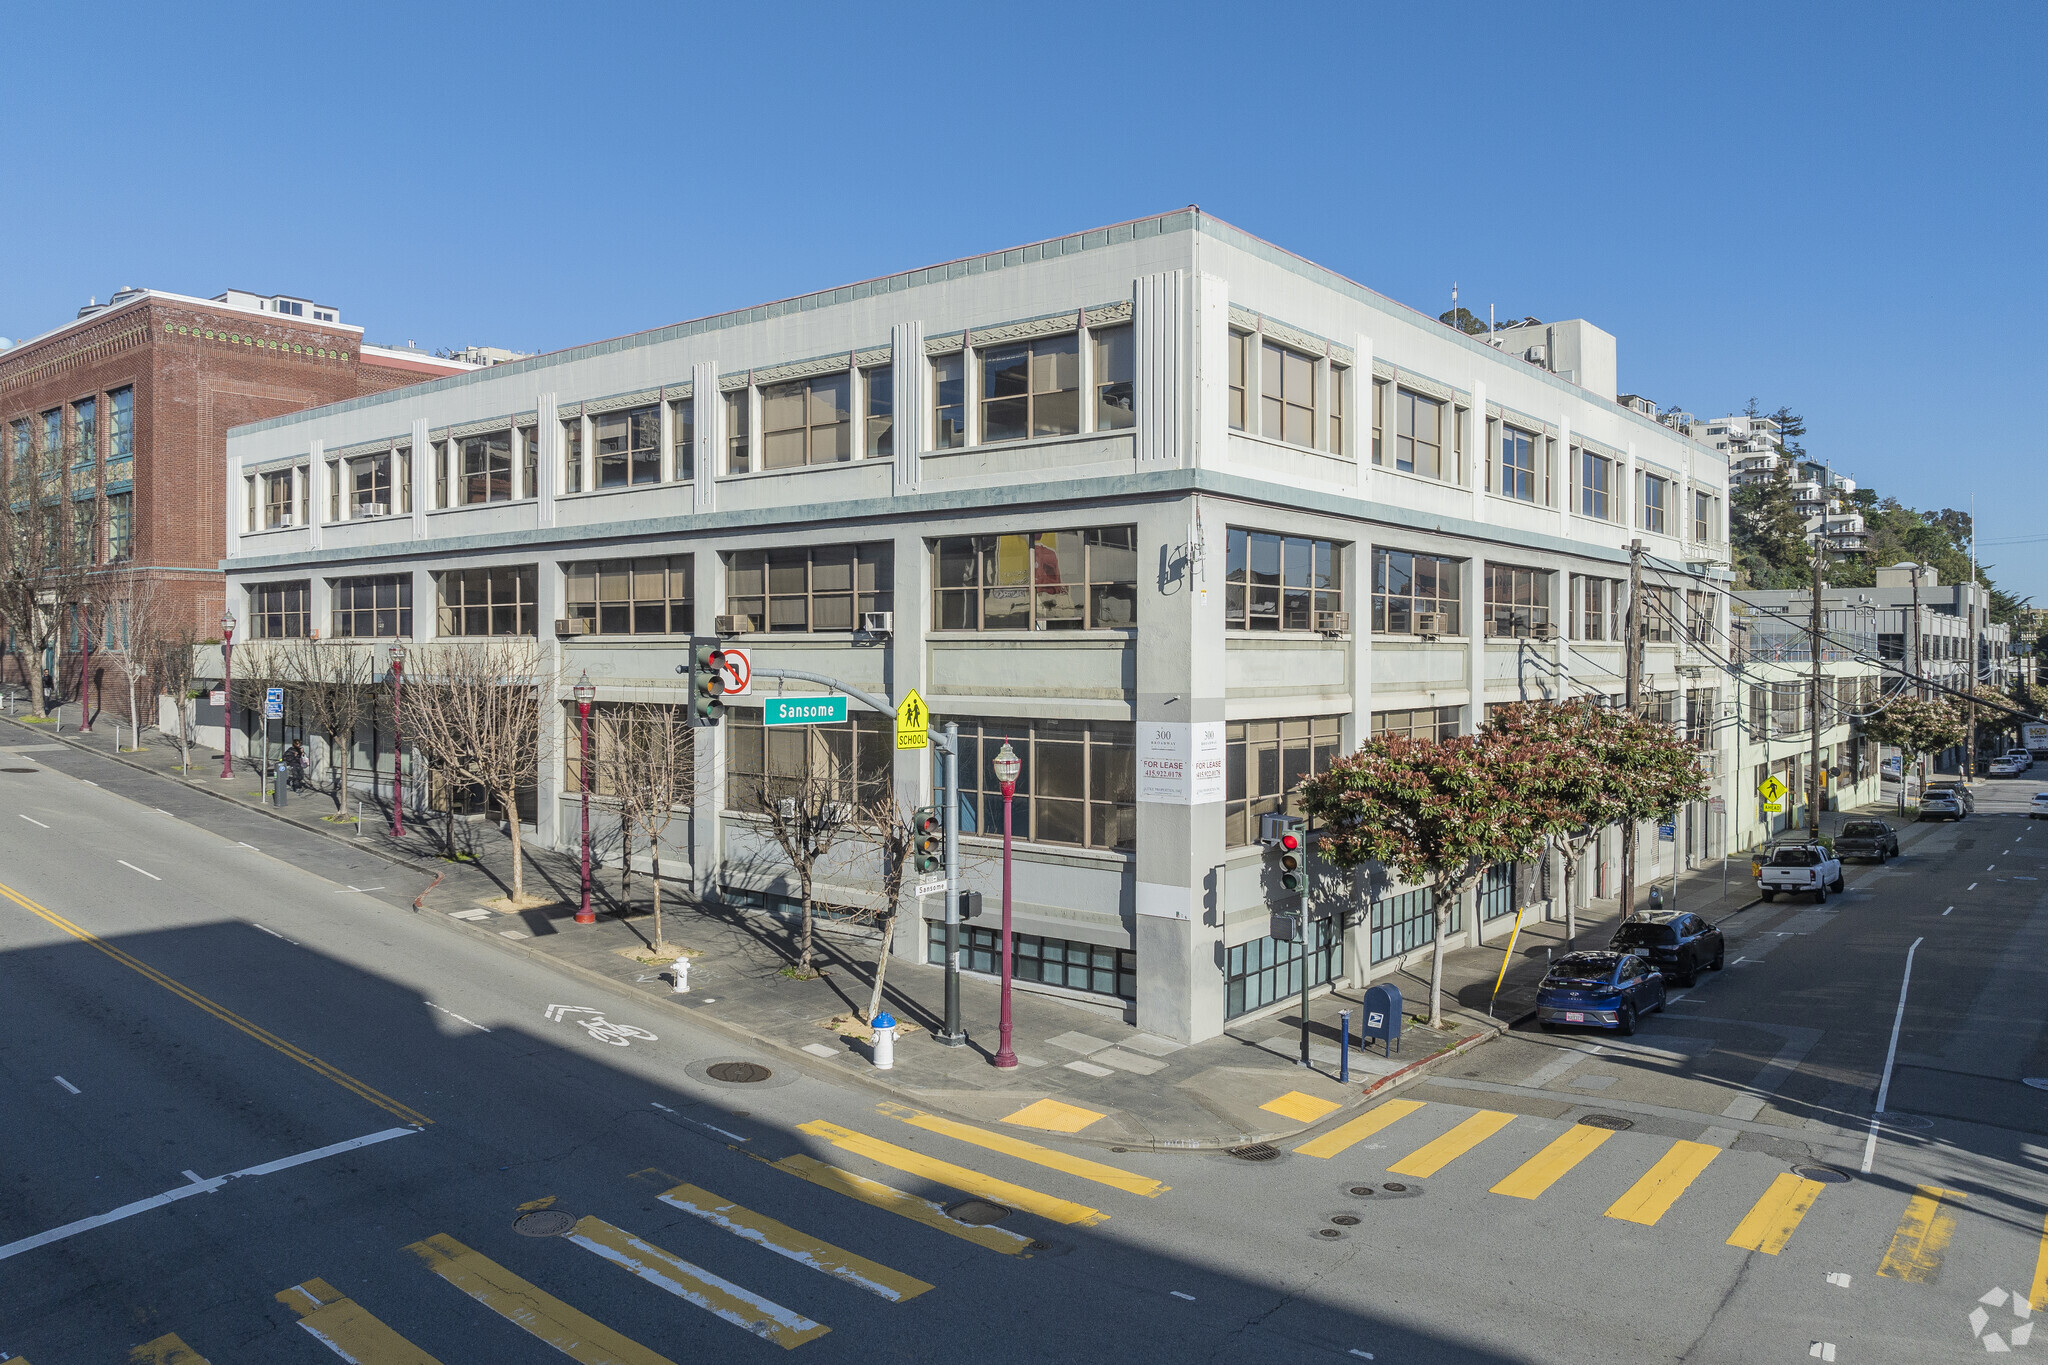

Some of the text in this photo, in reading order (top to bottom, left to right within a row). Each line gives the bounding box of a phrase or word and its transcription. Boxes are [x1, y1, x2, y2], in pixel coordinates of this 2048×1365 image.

[779, 703, 834, 718] Sansome
[899, 734, 925, 745] SCHOOL
[1155, 730, 1172, 740] 300
[1204, 730, 1215, 740] 300
[1143, 760, 1183, 769] FOR LEASE
[1195, 760, 1221, 770] FOR LEASE
[1145, 769, 1182, 778] 415.922.0178
[919, 884, 944, 894] Sansome
